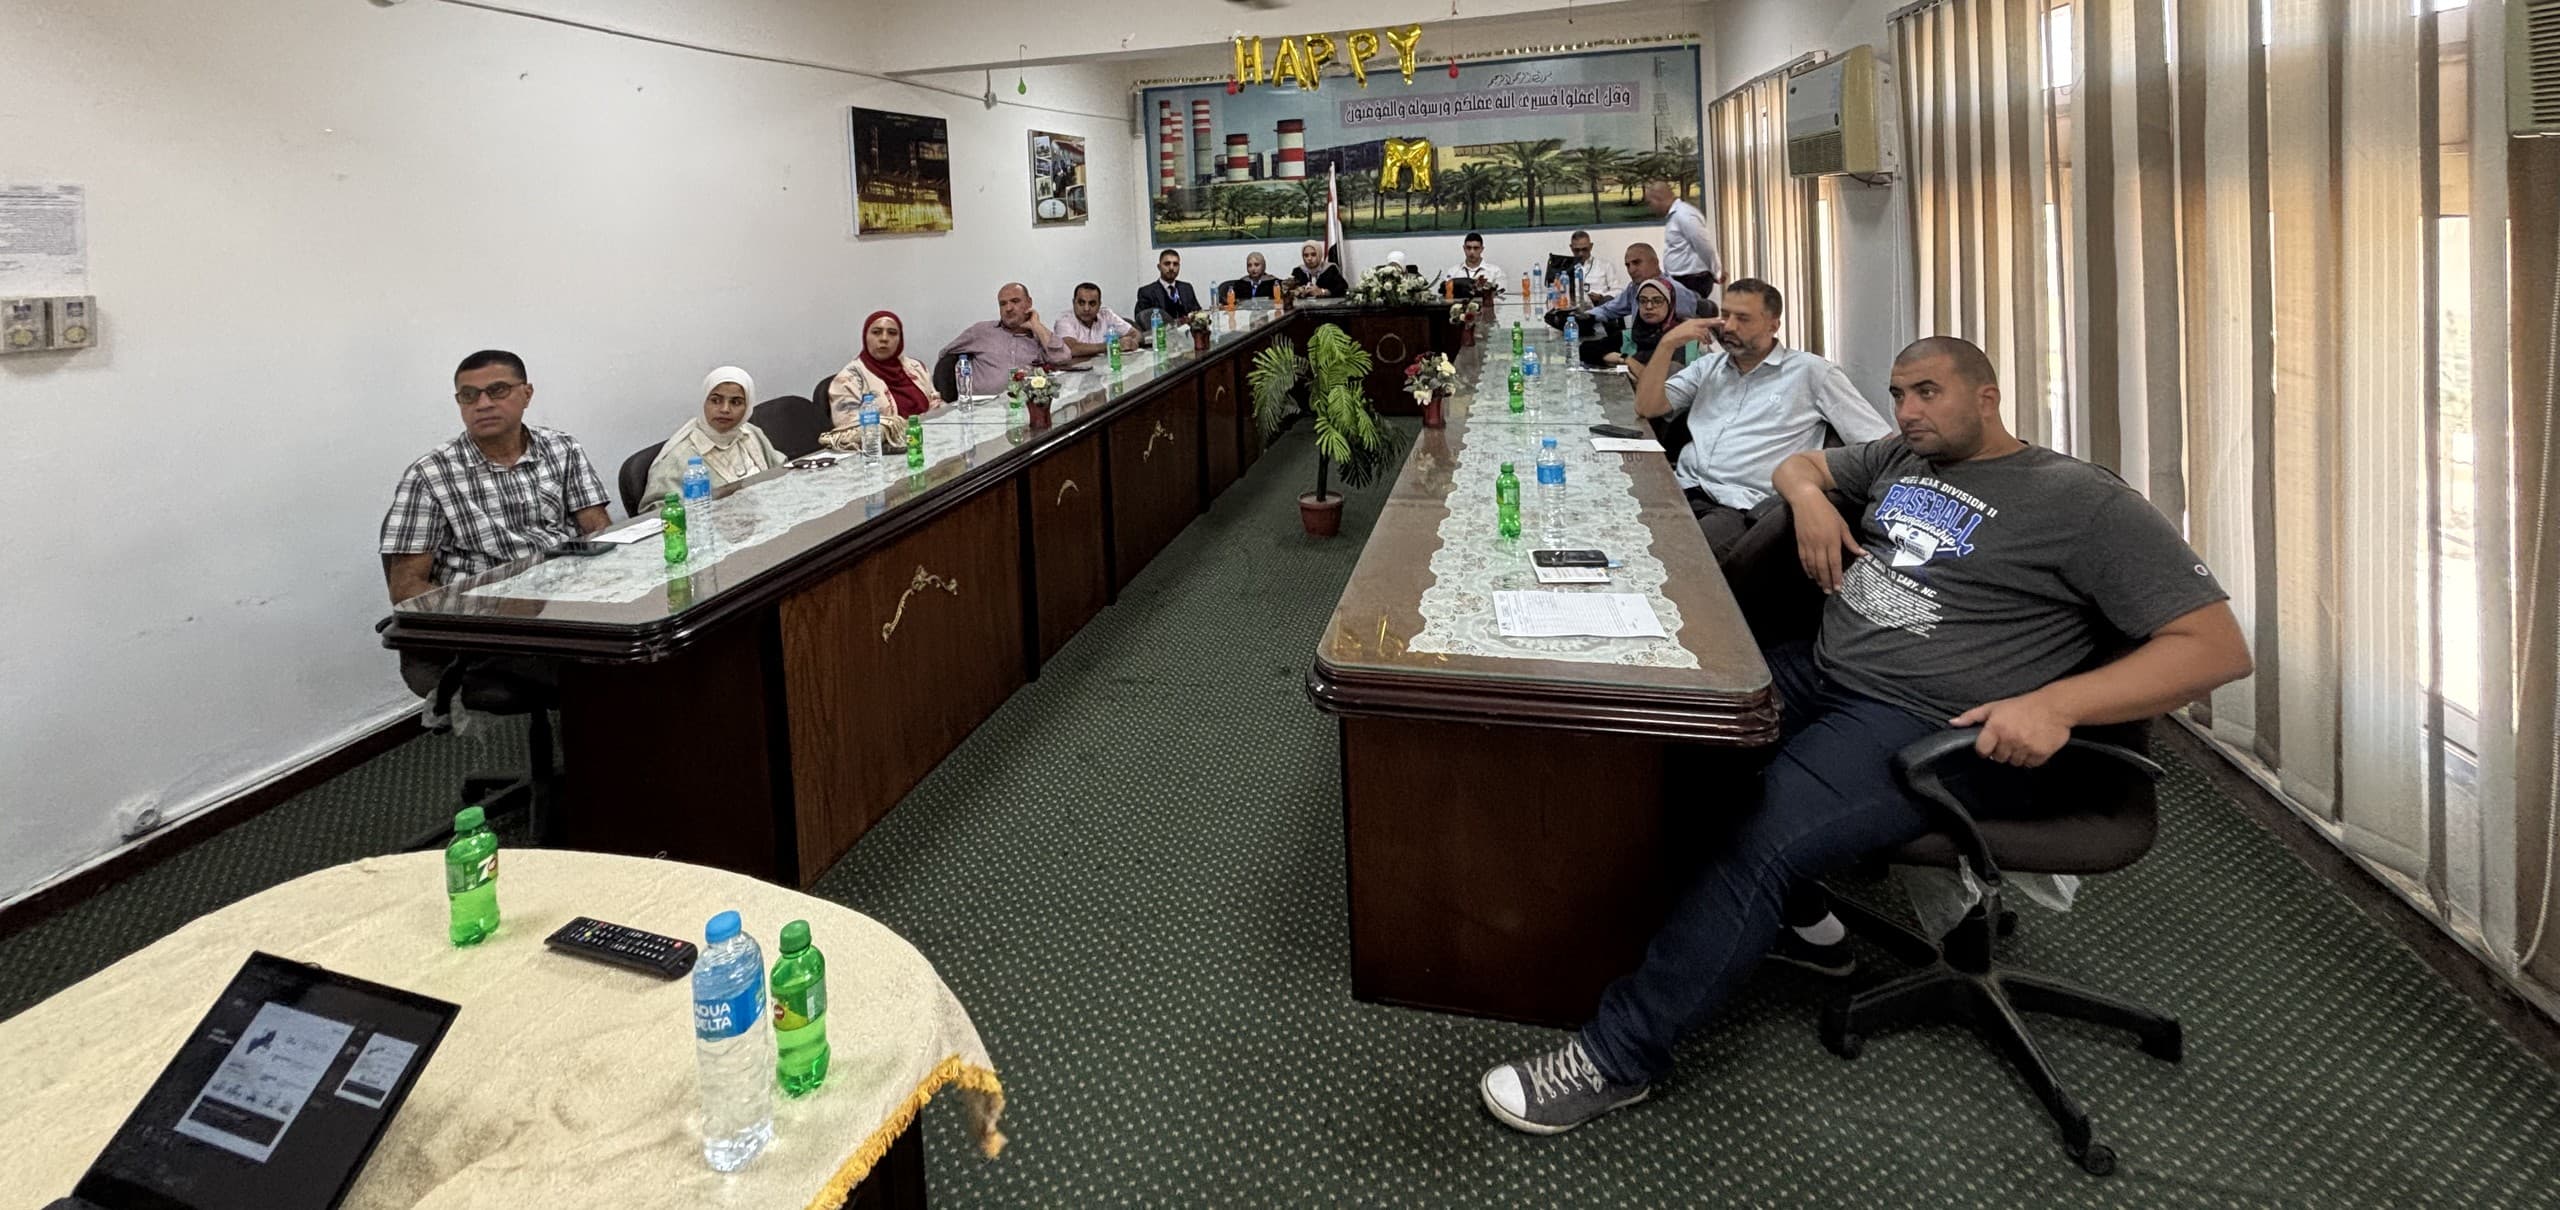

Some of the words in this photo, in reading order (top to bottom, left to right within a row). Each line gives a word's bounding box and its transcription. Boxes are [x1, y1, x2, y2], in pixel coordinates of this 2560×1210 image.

[1234, 23, 1422, 92] HAPPY
[1407, 97, 1451, 118] ورسوله
[1454, 93, 1493, 116] عملكم
[1495, 91, 1516, 110] الله
[1560, 86, 1600, 108] اعملوا
[1601, 84, 1632, 107] وقل
[1345, 99, 1405, 124] والمؤمنون
[1379, 137, 1432, 193] M
[1940, 483, 1987, 511] DIVISION
[1986, 507, 1999, 518] II
[1875, 484, 1983, 557] BASEBALL
[1884, 507, 1956, 547] Championship
